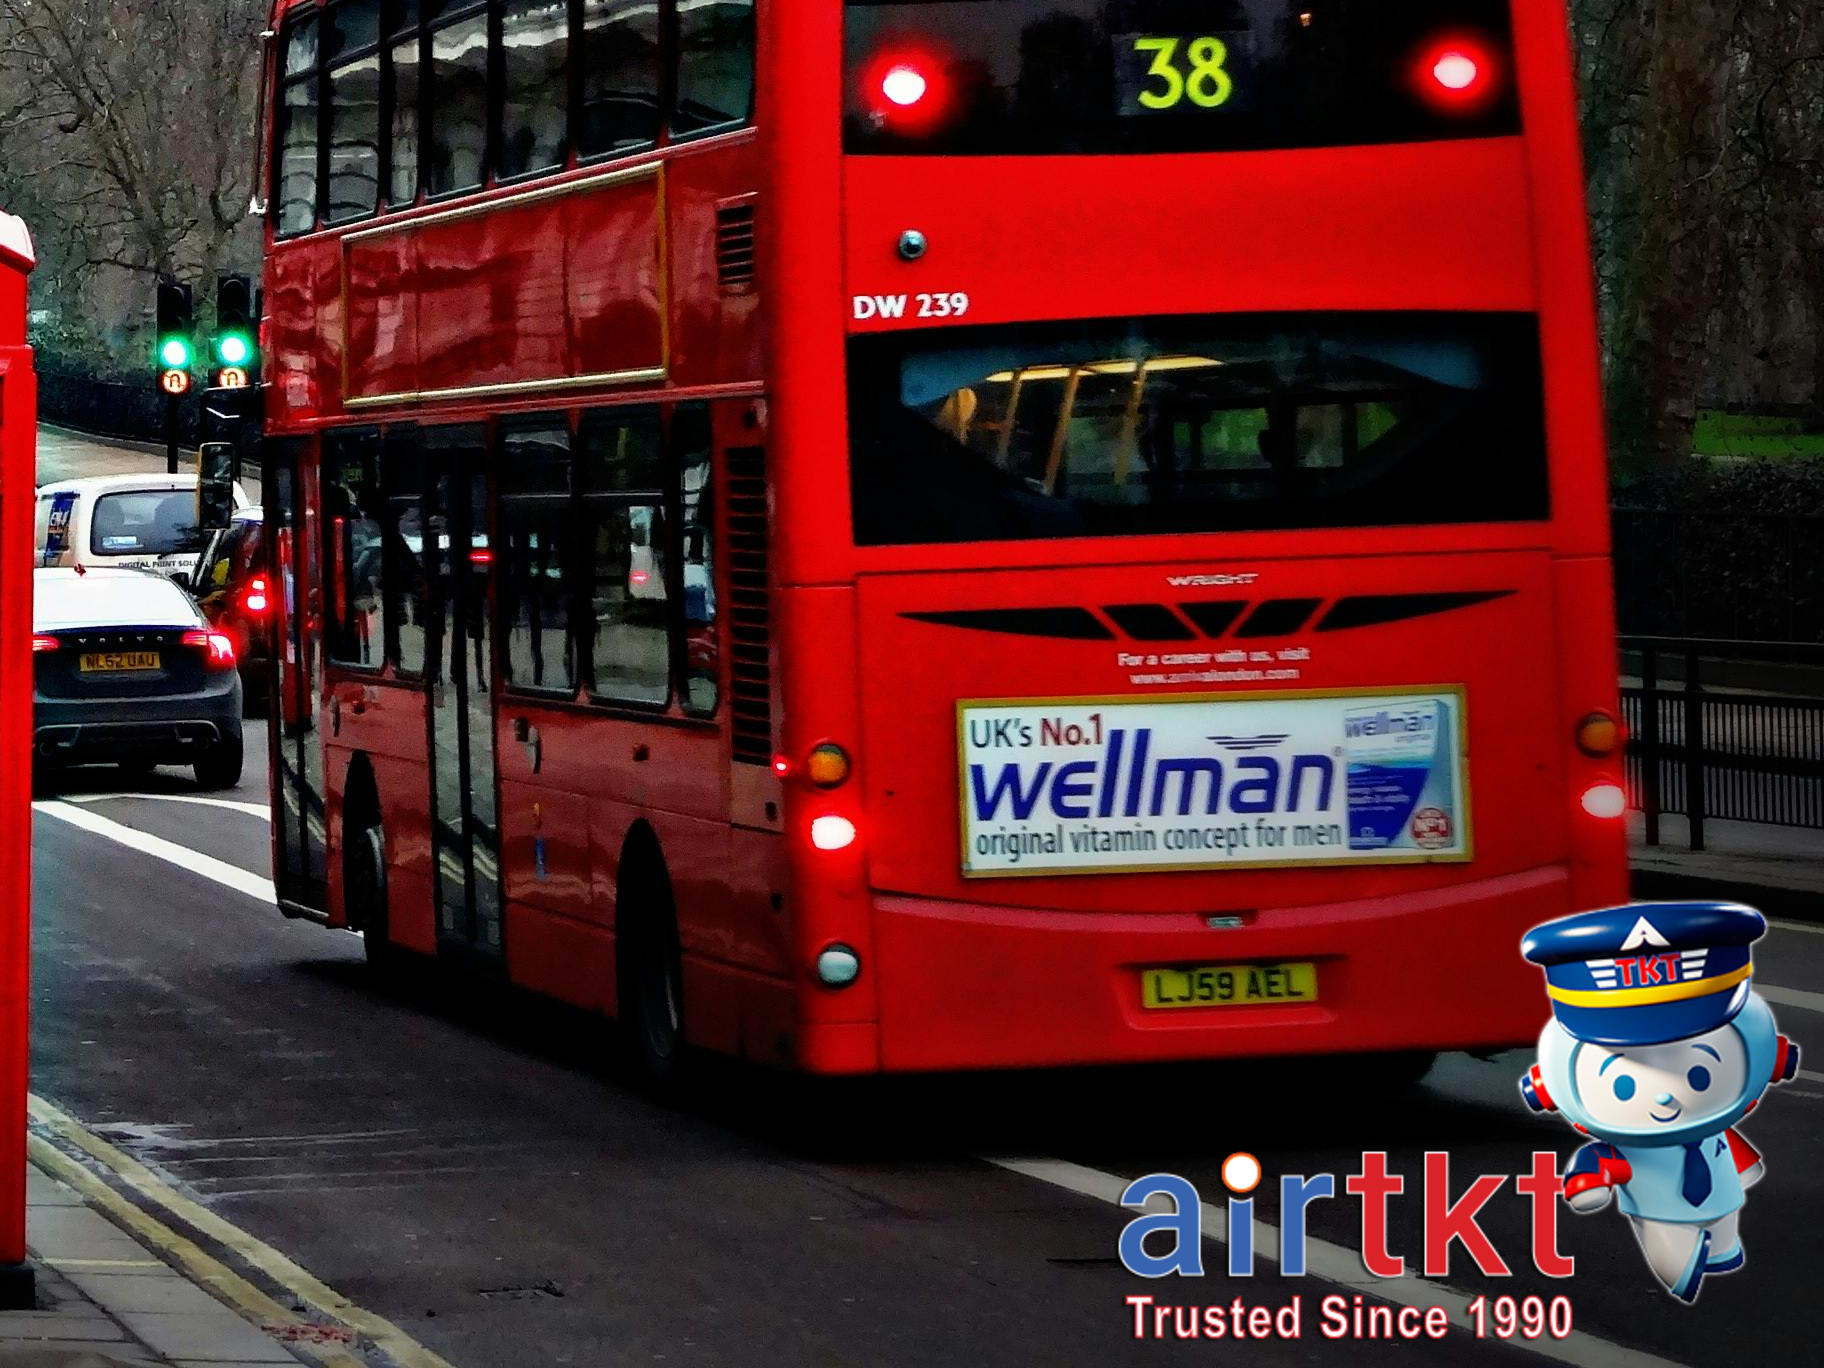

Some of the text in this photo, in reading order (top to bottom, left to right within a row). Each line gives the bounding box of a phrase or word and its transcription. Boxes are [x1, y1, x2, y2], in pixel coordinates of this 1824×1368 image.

[1133, 36, 1232, 111] 38
[853, 292, 969, 320] DW 239
[118, 561, 150, 569] DIGITAL
[152, 560, 176, 568] PRINT
[1166, 573, 1259, 586] WRIGHT
[1117, 652, 1144, 667] For
[1146, 655, 1159, 666] a
[1160, 652, 1212, 665] career
[1214, 649, 1248, 663] with
[1276, 647, 1311, 660] visit
[969, 713, 1104, 748] UK's No.1
[969, 728, 1335, 821] wellman
[976, 818, 1342, 863] original vitamin concept for men
[1155, 969, 1305, 1004] LJ59 AEL
